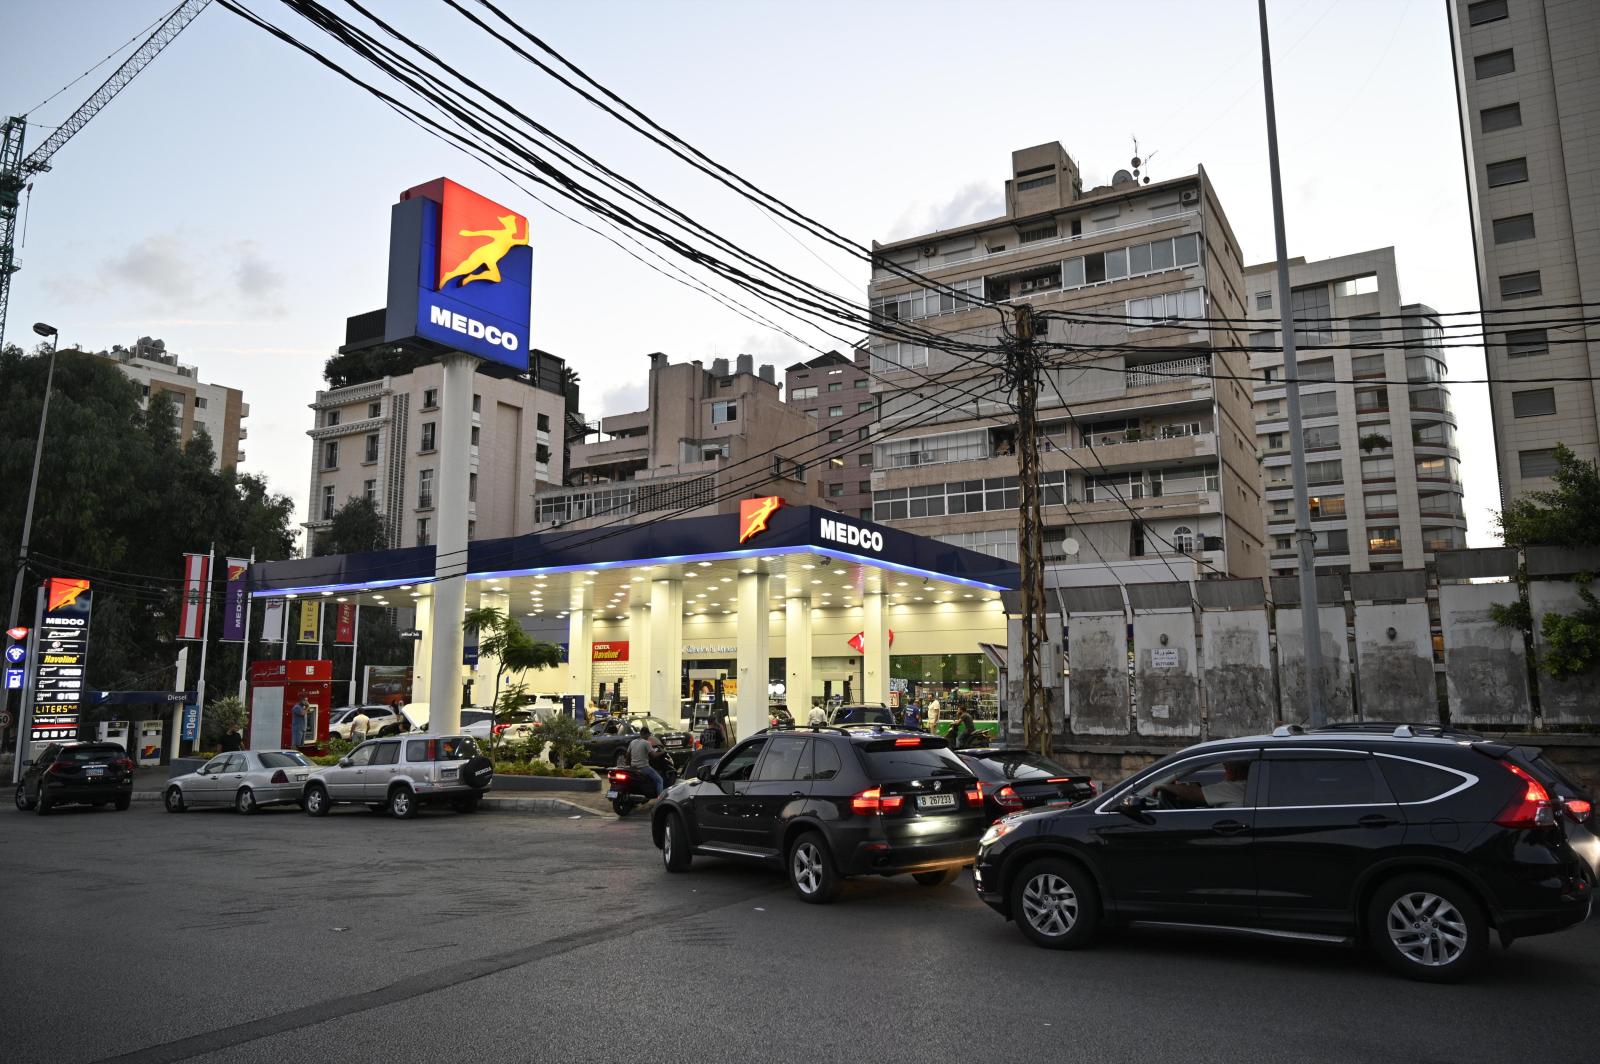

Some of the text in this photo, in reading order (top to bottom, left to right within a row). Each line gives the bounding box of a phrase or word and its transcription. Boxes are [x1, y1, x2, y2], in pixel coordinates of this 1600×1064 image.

[430, 305, 518, 351] MEDCO
[820, 517, 883, 552] MEDCO
[46, 617, 84, 626] MEDCO
[235, 589, 243, 628] MEDCO
[306, 599, 314, 627] LITER
[36, 705, 68, 713] LITERS
[186, 710, 197, 729] Delo
